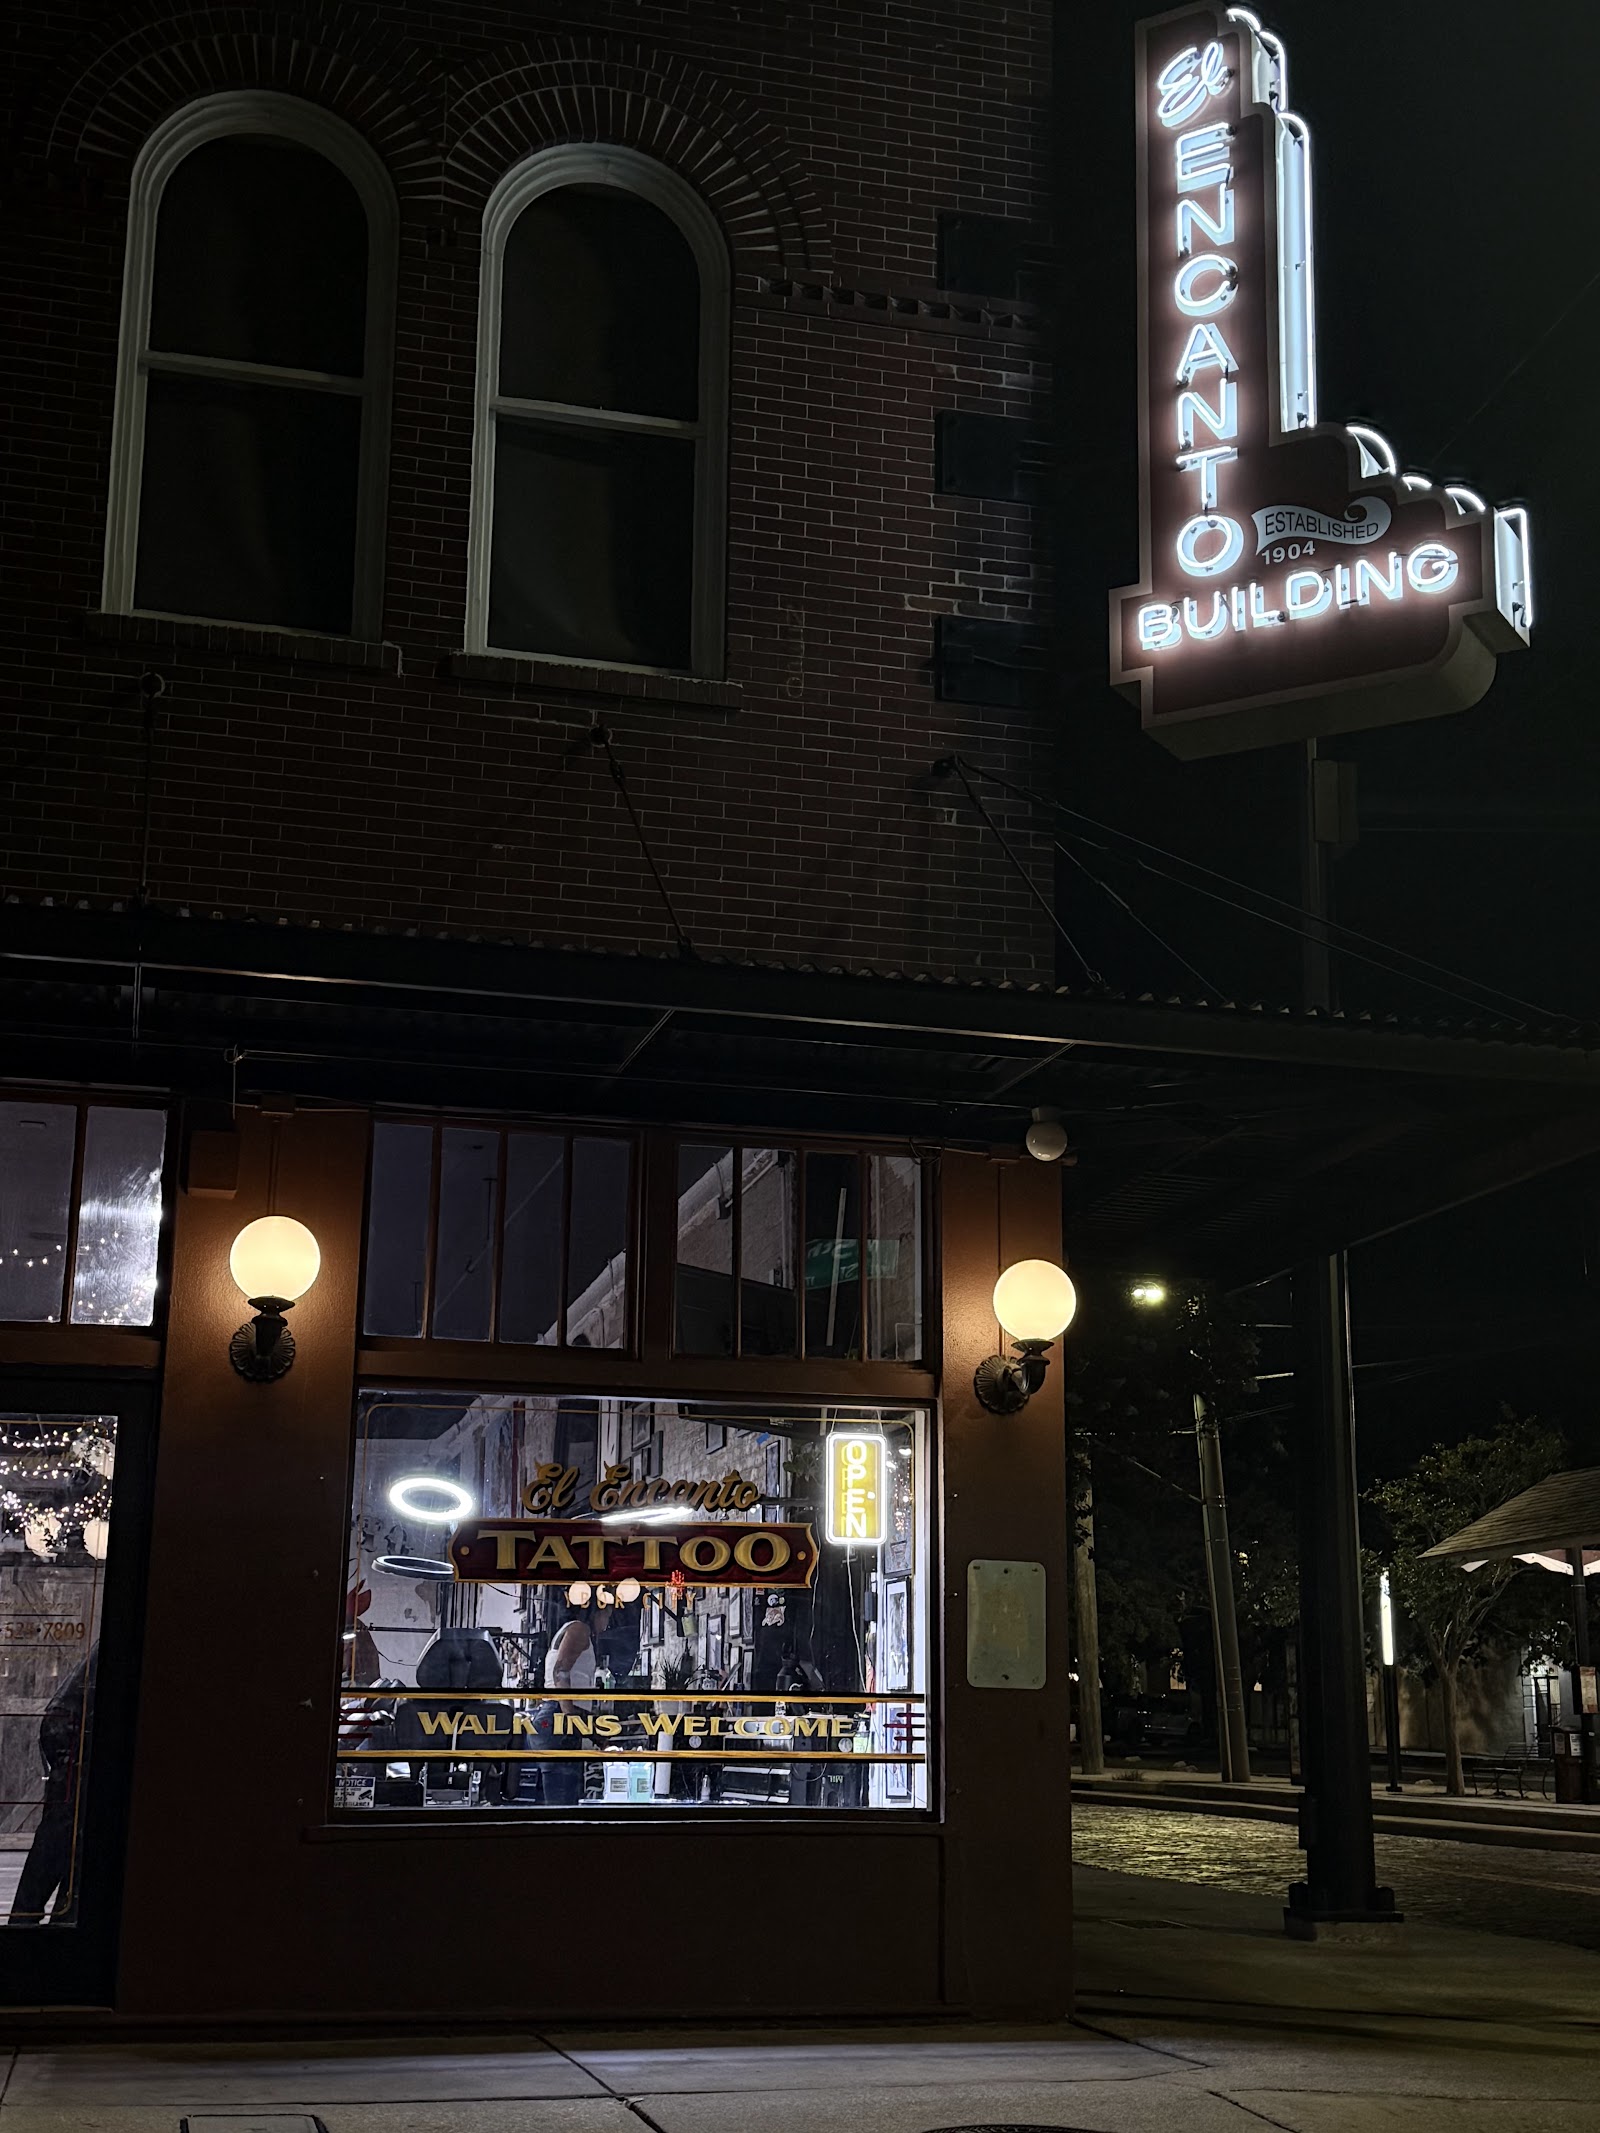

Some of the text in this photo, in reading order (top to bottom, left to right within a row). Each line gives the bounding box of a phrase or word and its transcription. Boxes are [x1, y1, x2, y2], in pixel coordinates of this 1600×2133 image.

[1157, 41, 1233, 126] El
[1174, 123, 1244, 578] ENCANTO
[1264, 511, 1379, 537] ESTABLISHED
[1261, 540, 1316, 565] 1904
[1138, 543, 1459, 650] BUILDING
[521, 1460, 761, 1514] El Encanto
[845, 1440, 867, 1537] OPEN
[477, 1529, 791, 1573] TATTOO
[417, 1711, 857, 1737] WALK INS WELCOME
[338, 1778, 367, 1787] NOTICE
